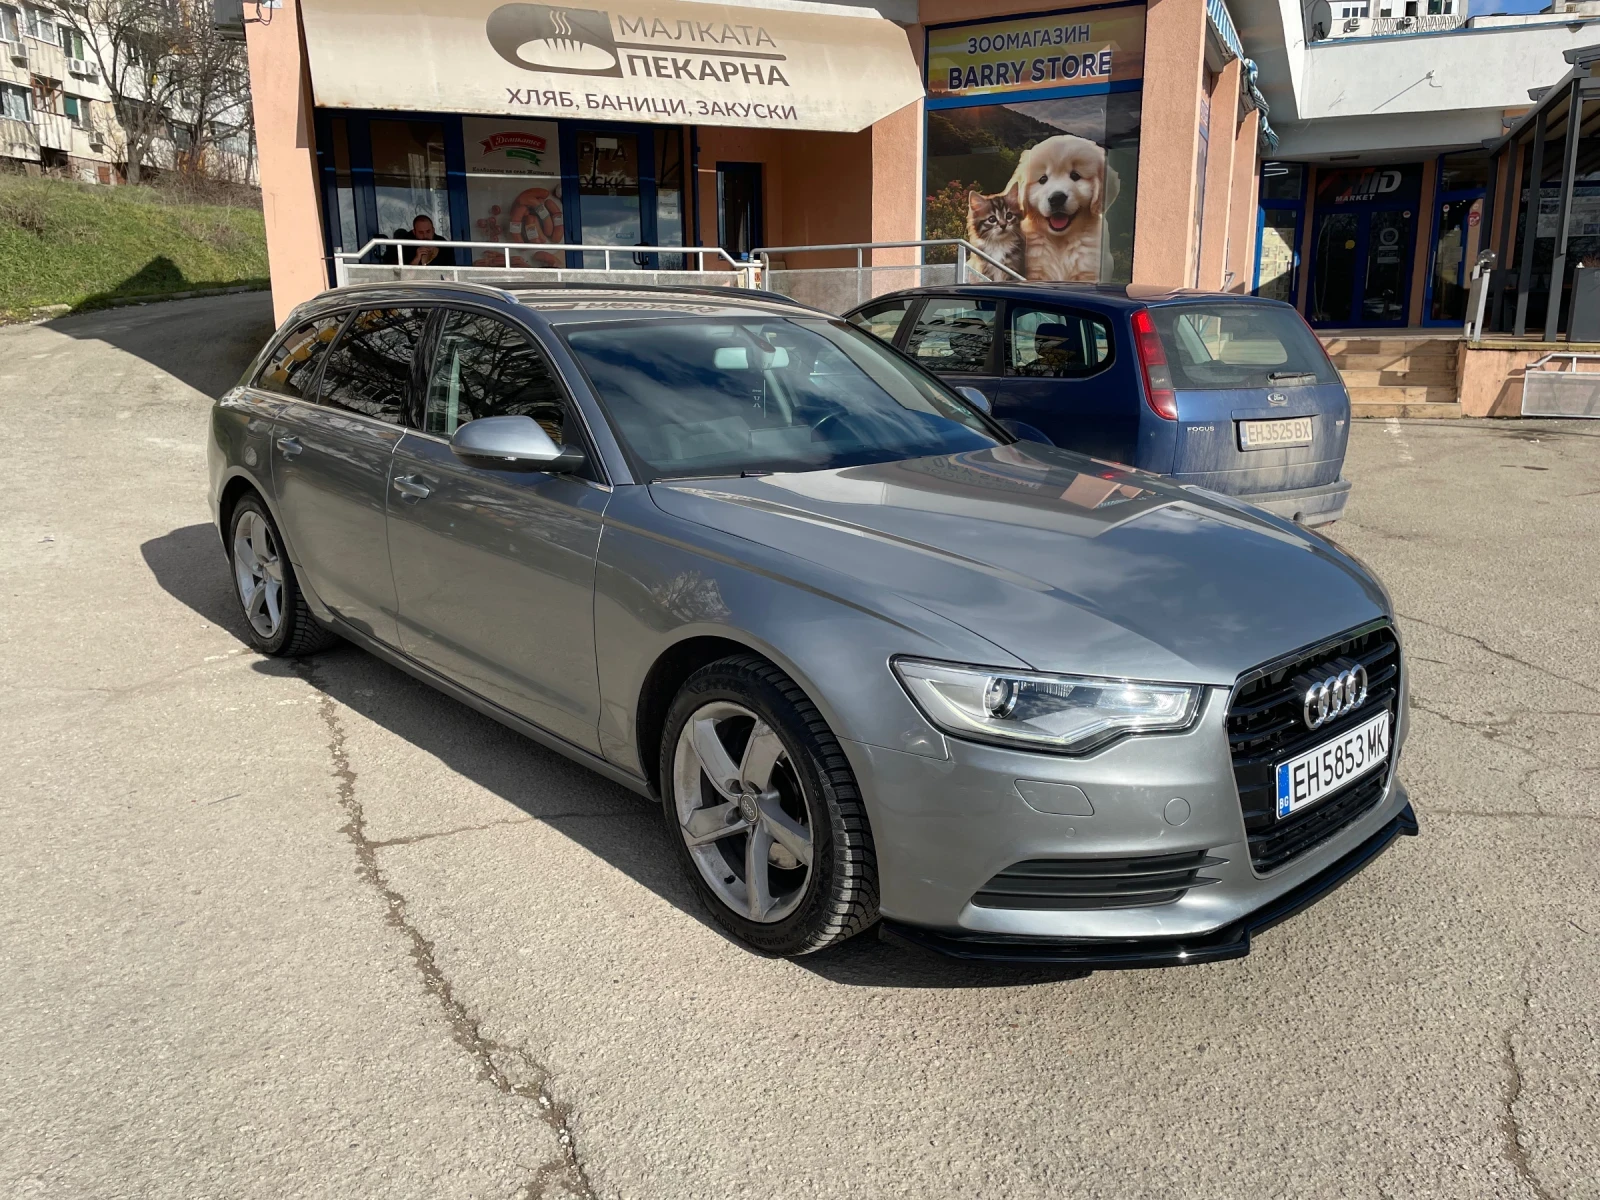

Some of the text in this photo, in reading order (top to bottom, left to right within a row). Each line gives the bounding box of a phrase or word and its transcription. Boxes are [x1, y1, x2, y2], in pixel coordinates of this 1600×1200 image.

[616, 14, 777, 48] МАЛКАТА
[967, 24, 1090, 55] ЗООМАГАЗИН
[626, 54, 790, 87] ПЕКАРНА
[948, 51, 1113, 91] BARRY STORE
[506, 88, 798, 120] ХЛЯБ, БАНИЦИ, ЗАКУСКИ
[1335, 193, 1375, 202] MARKET
[1323, 734, 1364, 786] 5853
[1279, 796, 1289, 809] BG
